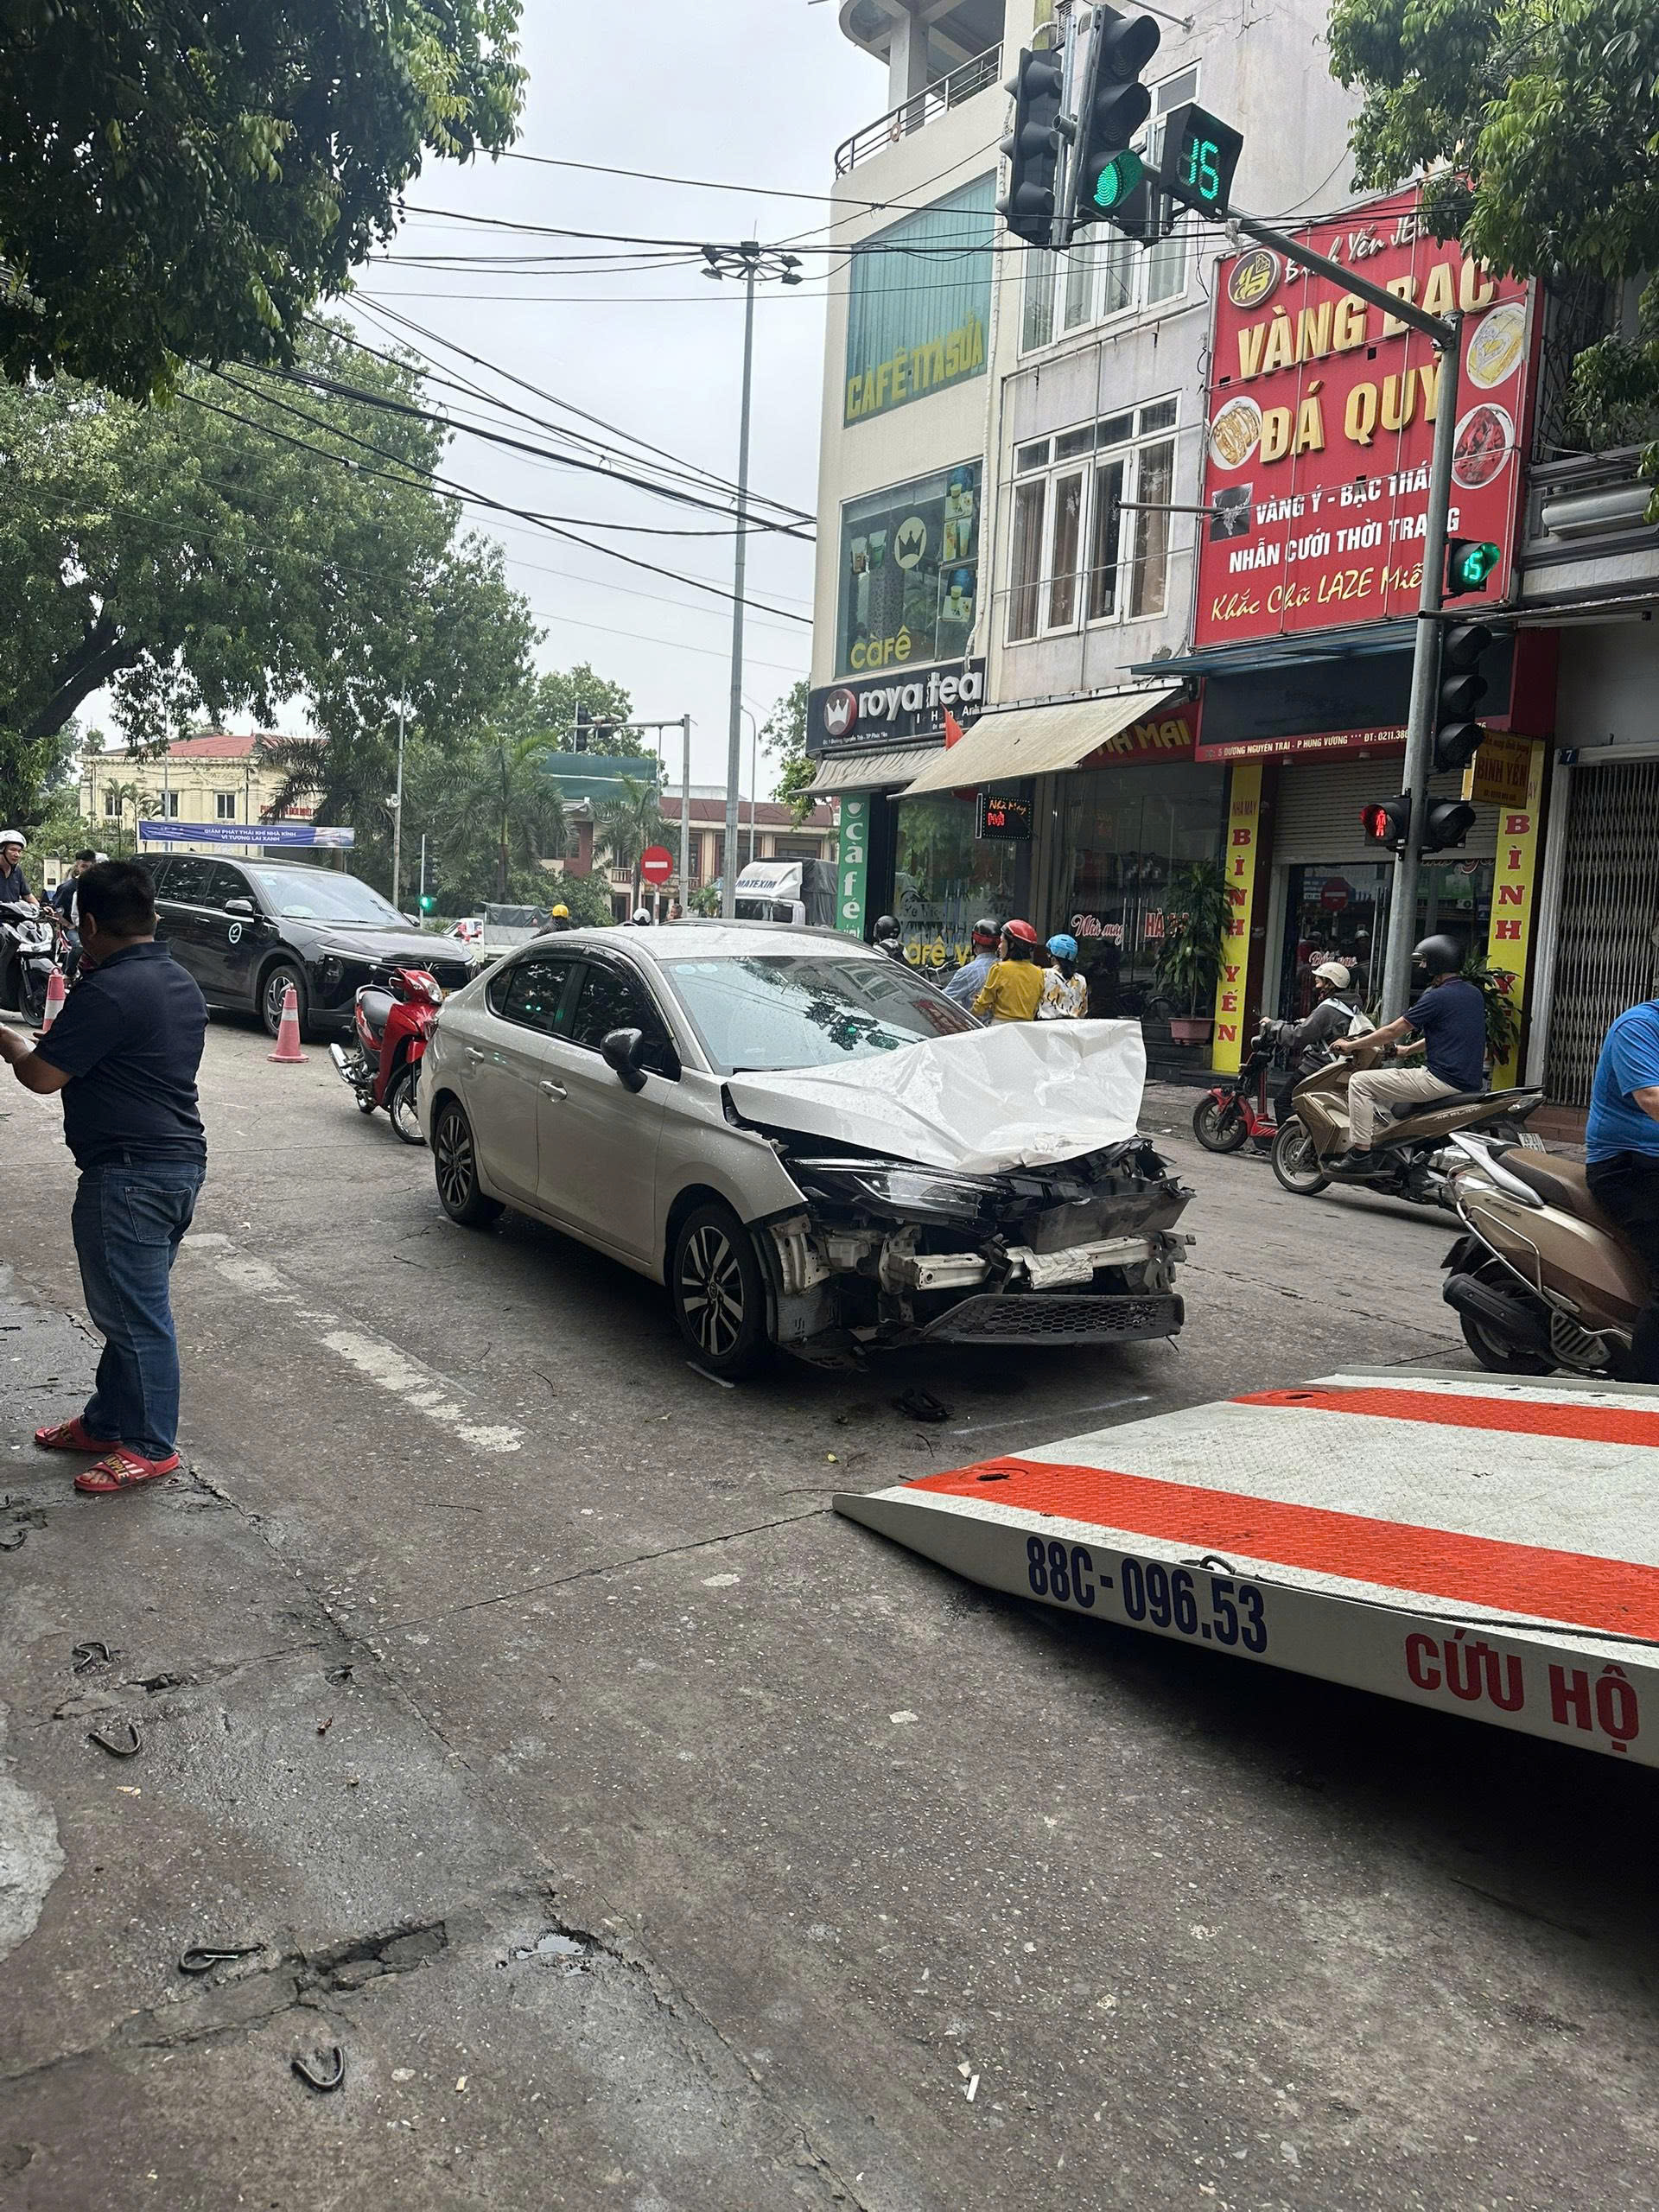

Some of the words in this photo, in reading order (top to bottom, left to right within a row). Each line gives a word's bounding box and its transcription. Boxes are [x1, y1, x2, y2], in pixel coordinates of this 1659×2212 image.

[1189, 138, 1219, 200] 15
[1237, 296, 1368, 381] VÀNG
[1259, 379, 1325, 464] ĐÁ
[1255, 495, 1306, 525] VÀNG
[1311, 484, 1323, 513] Ý
[1340, 476, 1382, 509] BẠC
[1229, 537, 1281, 574] NHẪN
[1285, 528, 1332, 563] CƯỚI
[1336, 518, 1382, 553] THỜI
[1388, 507, 1460, 543] TRAG
[1463, 550, 1484, 580] 15
[1211, 588, 1261, 623] Khắc
[1267, 582, 1311, 614] Chữ
[1316, 567, 1376, 604] LAZE
[1566, 749, 1573, 762] 7
[1404, 1628, 1525, 1712] CỨU
[1548, 1663, 1639, 1753] HỘ
